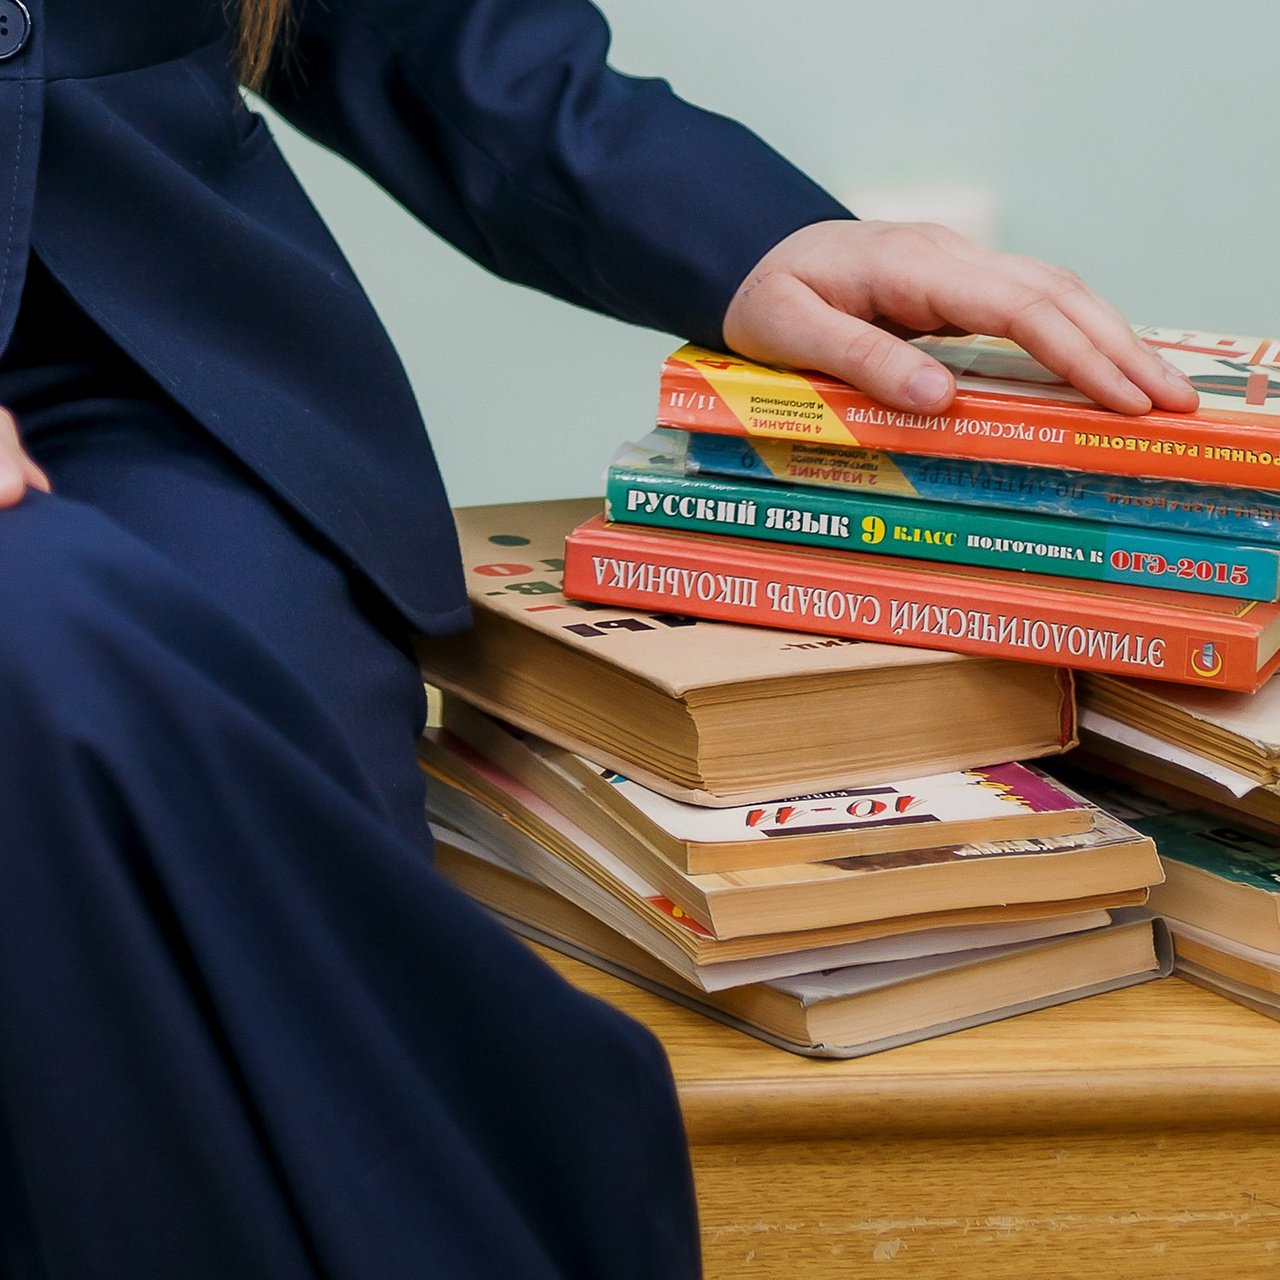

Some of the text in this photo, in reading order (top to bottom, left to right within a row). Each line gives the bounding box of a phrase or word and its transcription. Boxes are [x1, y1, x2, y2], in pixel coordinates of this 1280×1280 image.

[751, 396, 815, 409] ДОПОЛНЕННОЕ
[751, 406, 823, 420] ИСПРАВЛЕННОЕ
[749, 417, 823, 434] 4 ИЗДАНИЕ,
[846, 406, 951, 431] ЛИТЕРАТУРЕ
[954, 418, 1035, 441] РУССКОЙ
[1038, 427, 1065, 444] ПО
[1074, 432, 1200, 457] РАЗРАБОТКИ
[868, 473, 878, 485] 2
[918, 466, 1045, 496] ЛИТЕРАТУРЕ
[1056, 482, 1085, 500] ПО
[1106, 491, 1229, 517] РАЗРАБОТКИ
[627, 489, 758, 526] РУССКИЙ
[765, 507, 850, 538] ЯЗЫК
[861, 516, 886, 544] 9
[967, 534, 1085, 562] ПОДГОТОВКА
[1090, 550, 1104, 564] К
[1110, 549, 1249, 586] ОГЭ-2015
[591, 555, 759, 608] ШКОЛЬНИКА
[766, 581, 881, 627] СЛОВАРЬ
[889, 599, 1166, 668] ЭТИМОЛОГИЧЕСКИЙ
[745, 794, 928, 828] 10-11
